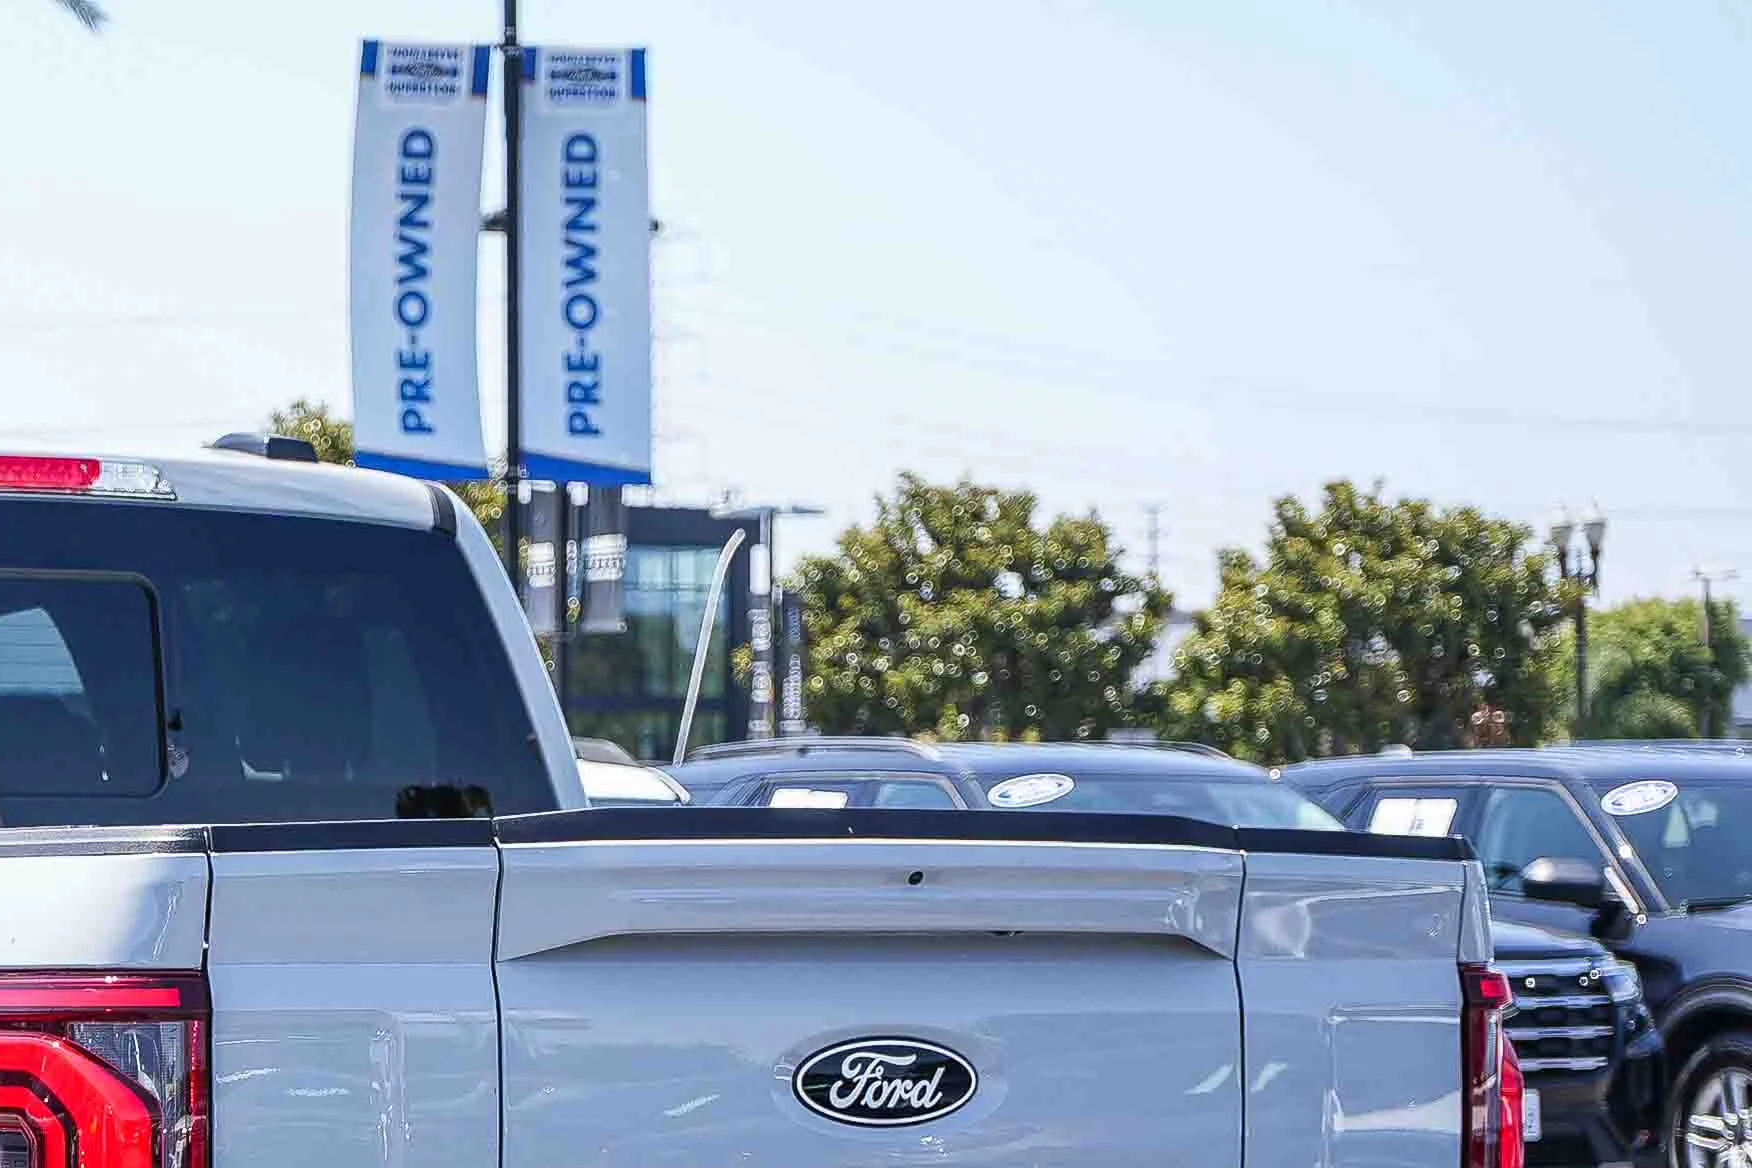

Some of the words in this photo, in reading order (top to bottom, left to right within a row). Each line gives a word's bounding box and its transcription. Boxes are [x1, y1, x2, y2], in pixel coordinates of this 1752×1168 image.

[394, 126, 437, 436] PRE-OWNED
[560, 131, 603, 438] PRE-OWNED
[829, 1051, 946, 1109] Ford
